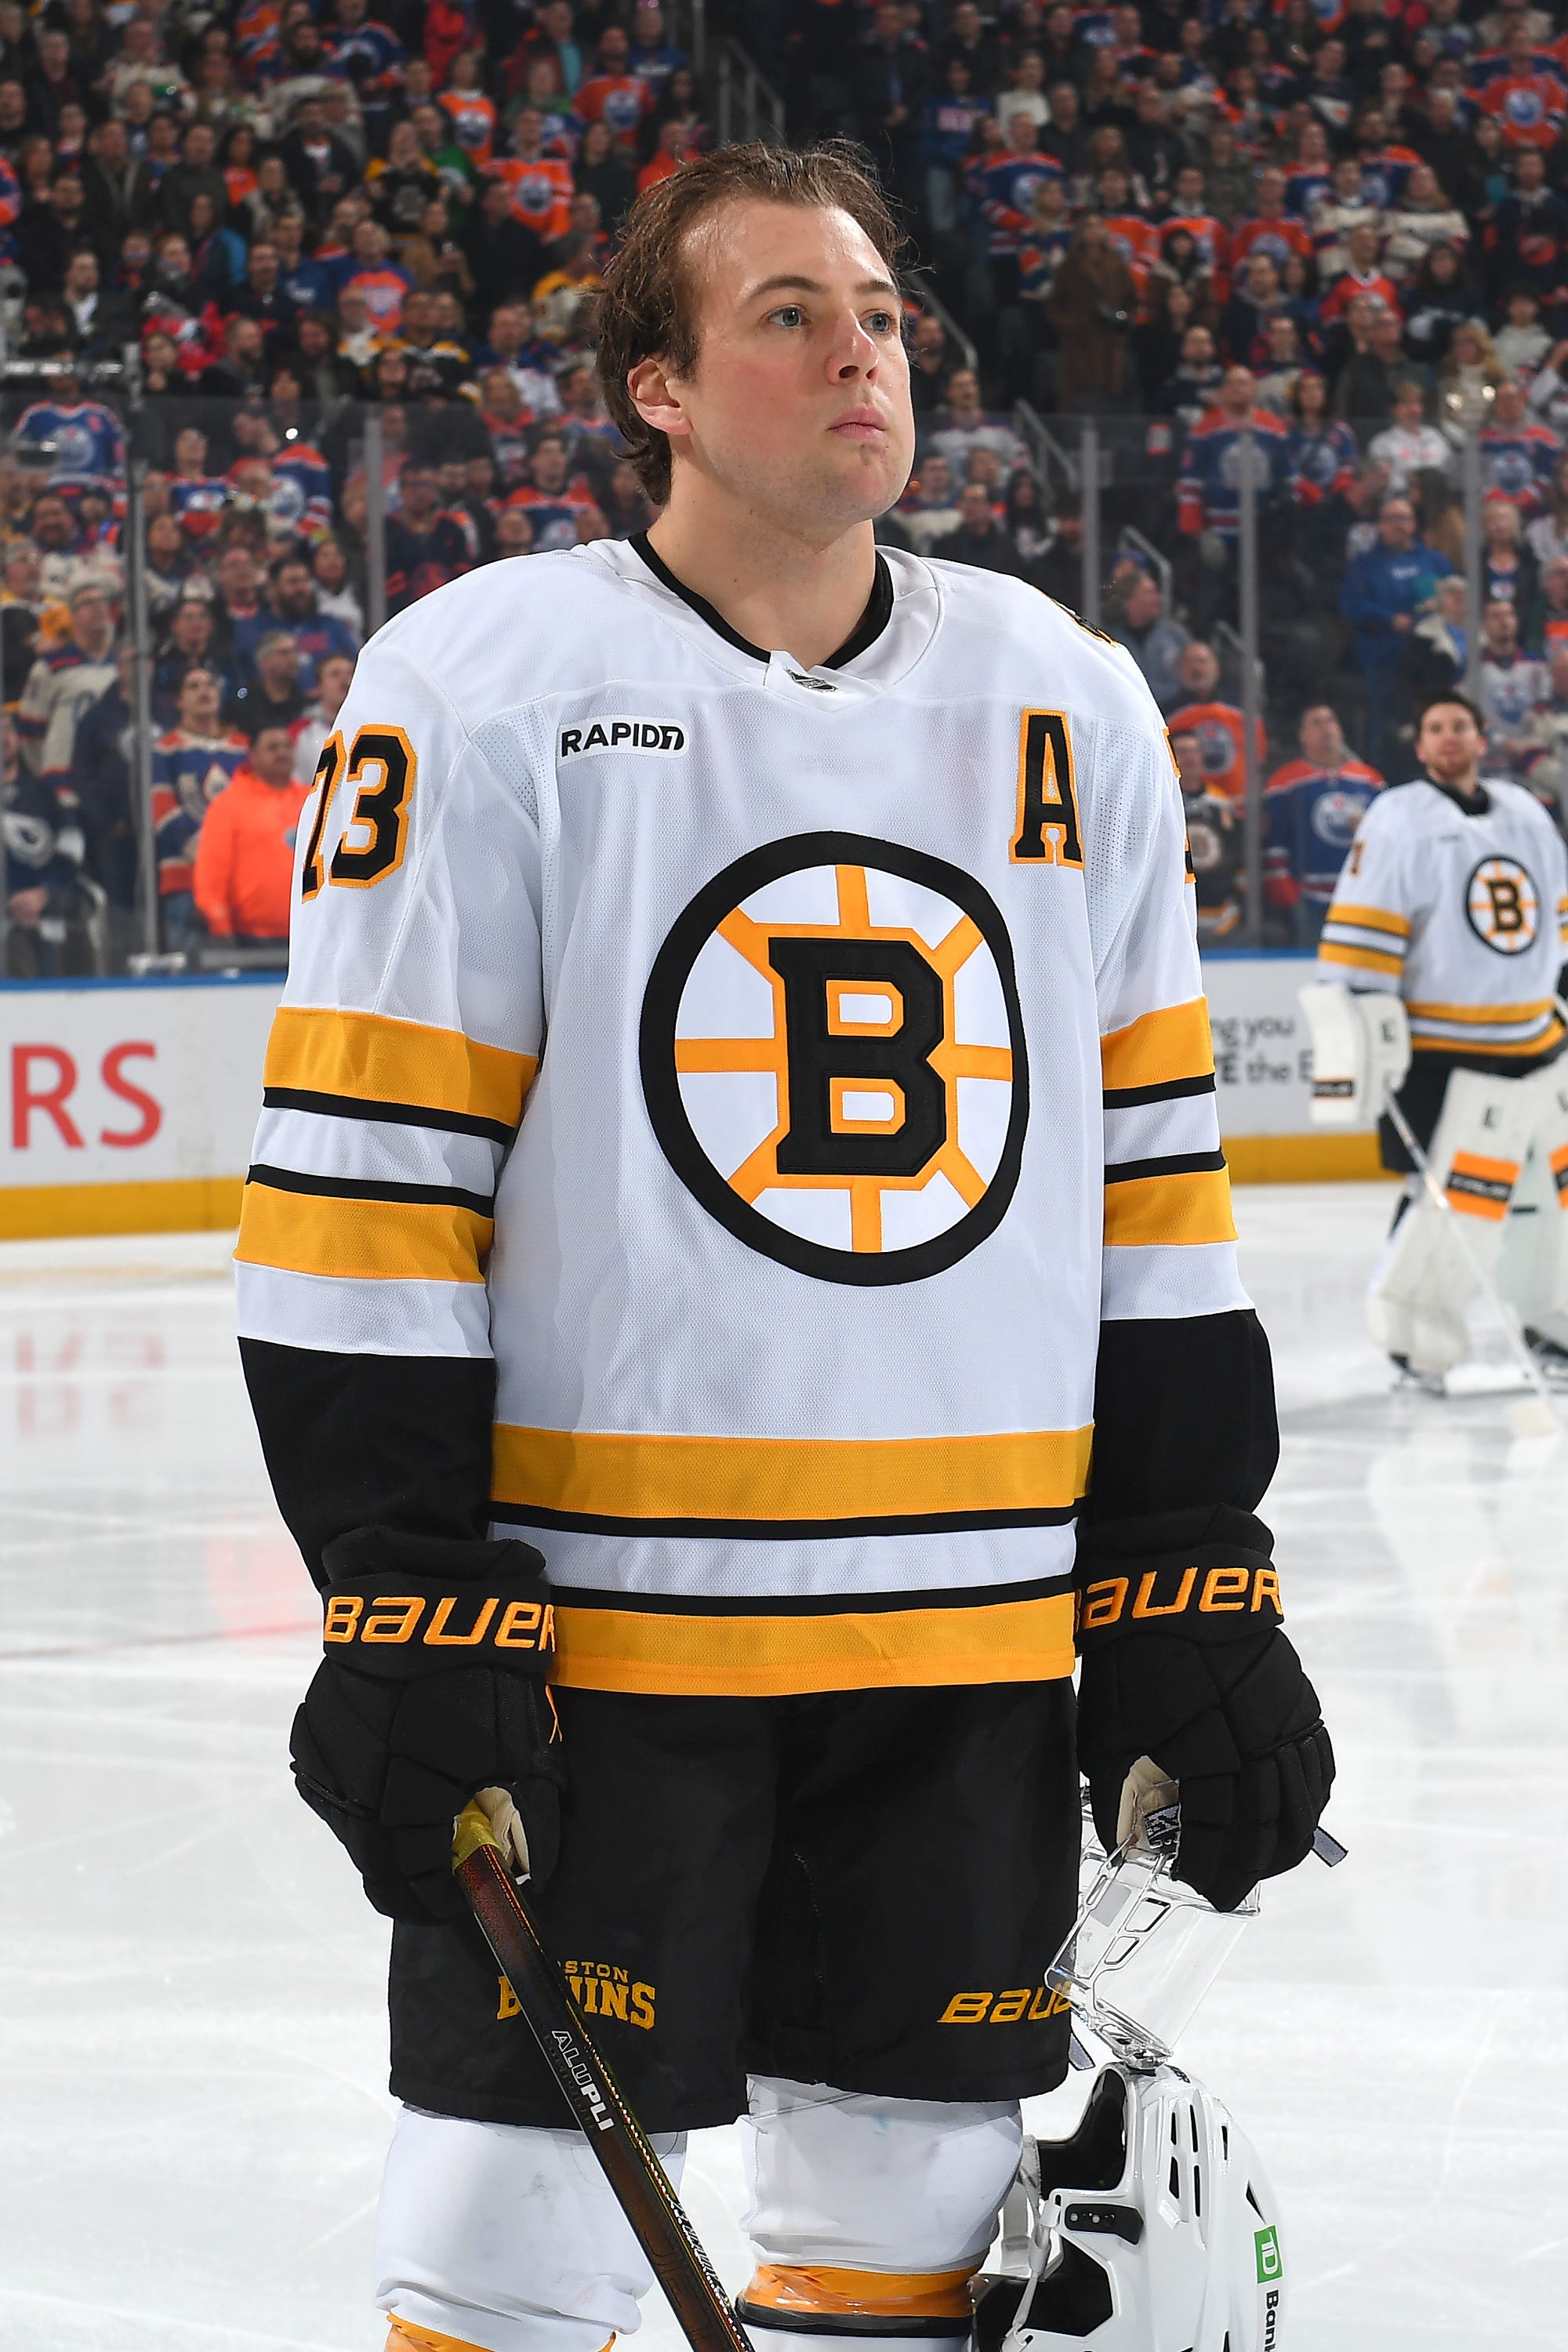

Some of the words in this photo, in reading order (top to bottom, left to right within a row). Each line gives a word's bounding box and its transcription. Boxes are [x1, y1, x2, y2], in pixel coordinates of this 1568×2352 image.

[561, 722, 684, 757] RAPID7
[301, 724, 419, 905] 73
[1008, 708, 1085, 870] A
[1486, 880, 1522, 931] B
[768, 936, 947, 1177] B
[1243, 1018, 1294, 1047] you
[11, 1040, 162, 1149] RS
[1247, 1051, 1292, 1083] the
[1074, 1566, 1283, 1633] AUER
[557, 1960, 629, 1983] STON
[496, 1975, 656, 2031] BINS
[551, 2030, 615, 2131] ALUPLI
[1261, 2231, 1278, 2275] TD
